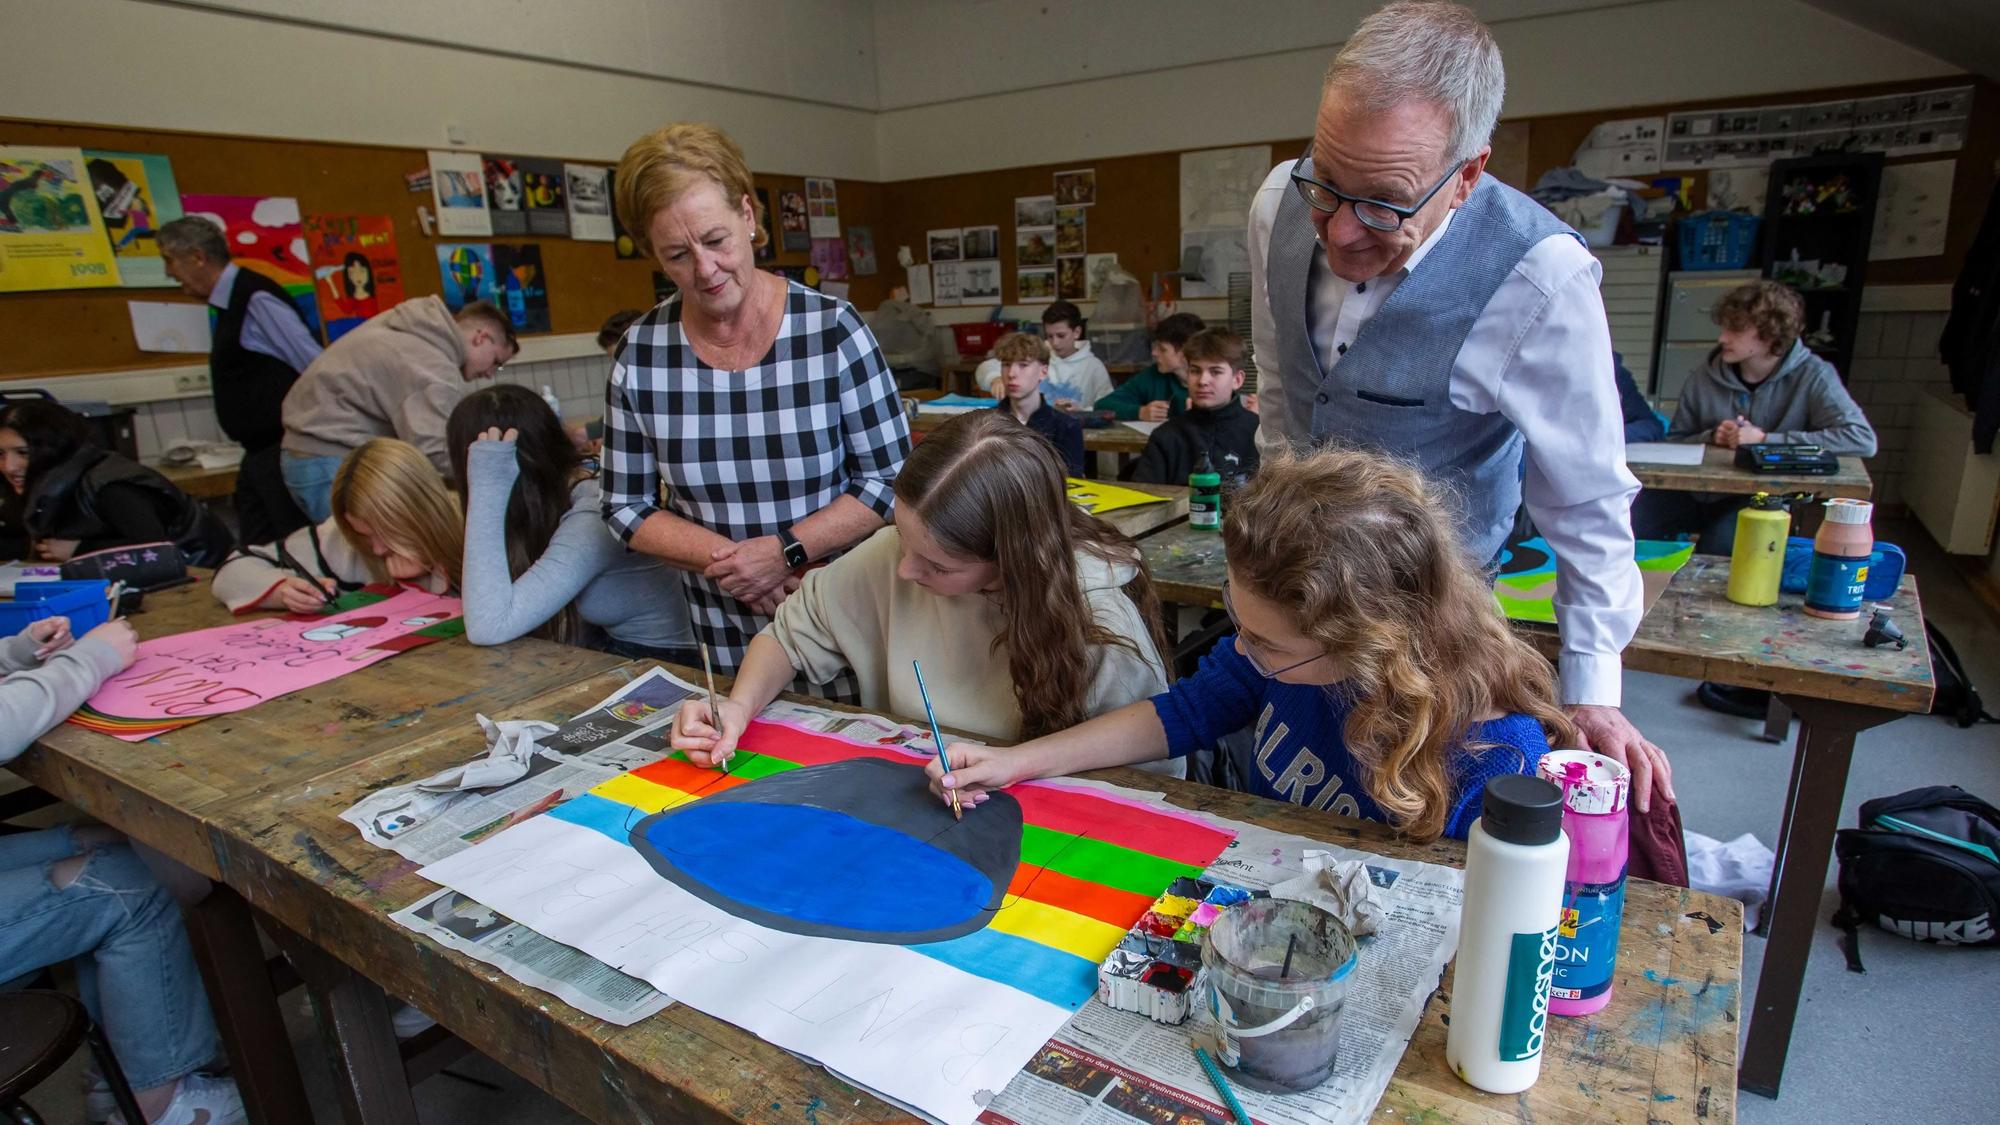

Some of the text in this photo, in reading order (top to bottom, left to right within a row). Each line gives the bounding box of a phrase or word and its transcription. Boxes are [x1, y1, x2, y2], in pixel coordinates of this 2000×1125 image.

[113, 658, 264, 716] BUN
[1879, 911, 1996, 944] NIKE
[1046, 1041, 1085, 1061] chienenbus
[1084, 1056, 1095, 1065] zu
[1095, 1058, 1110, 1070] den
